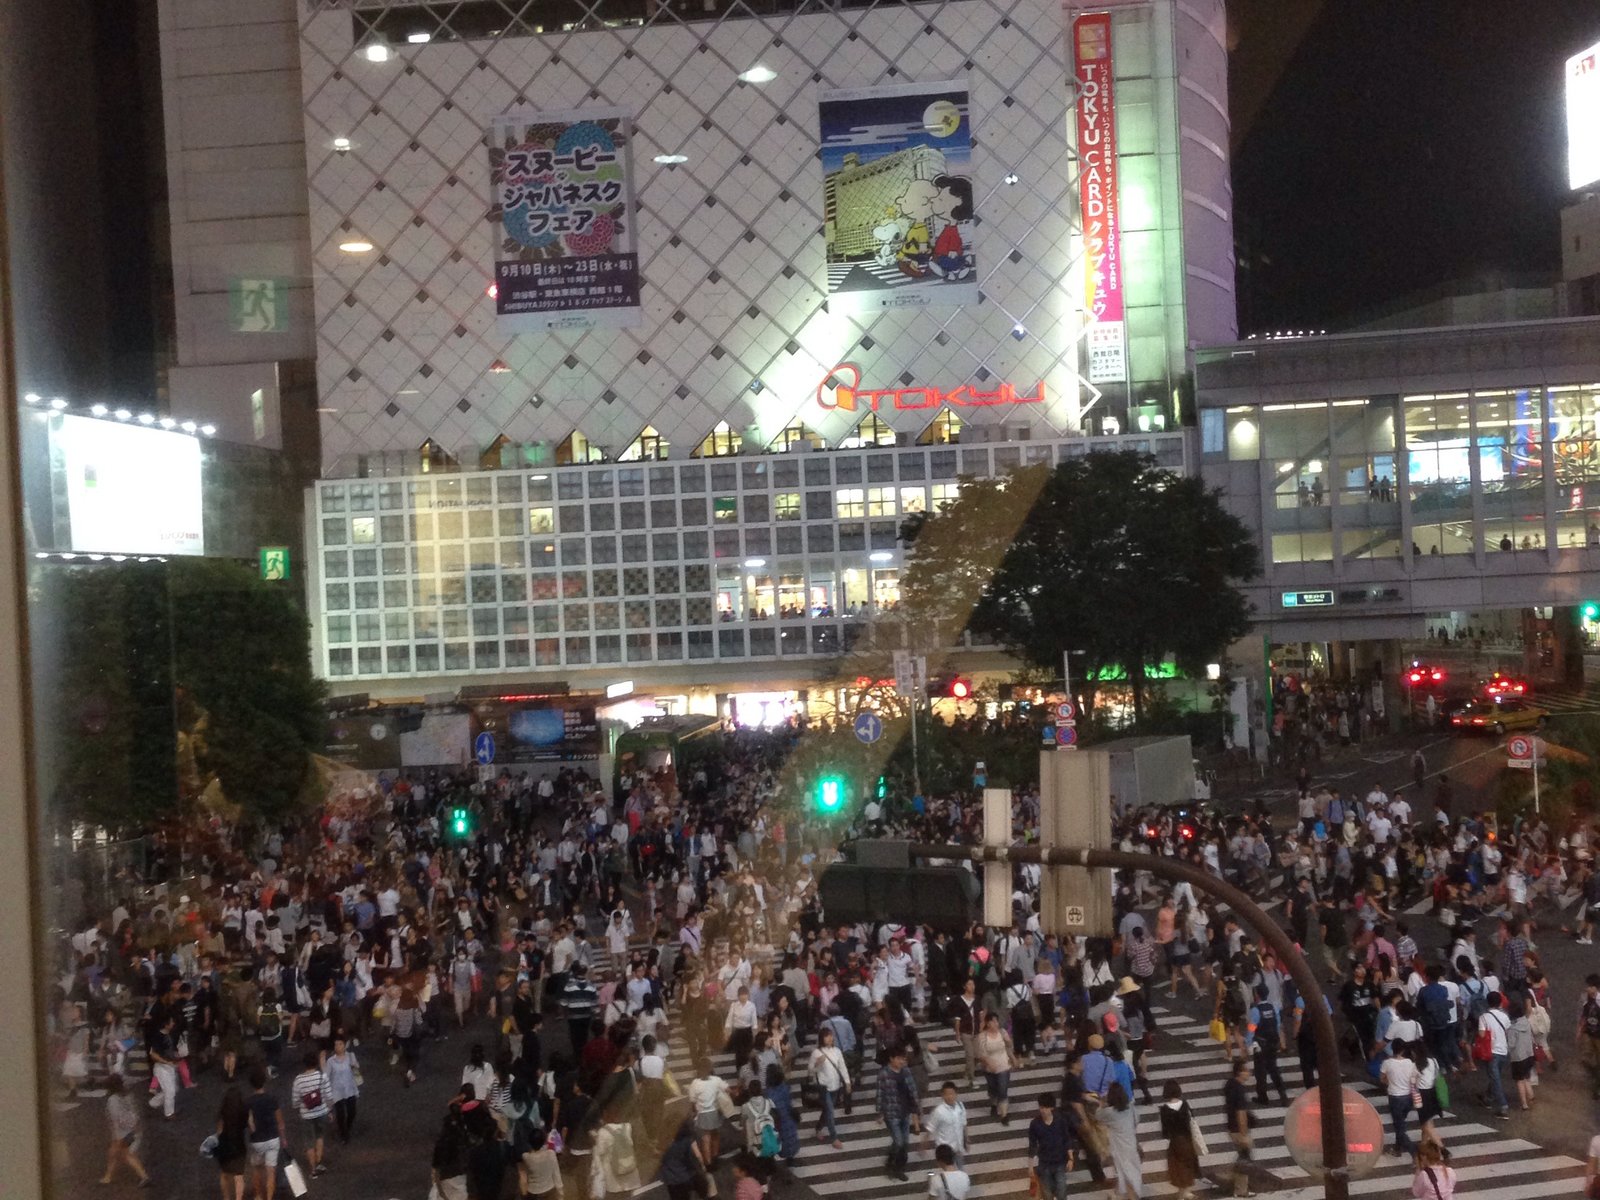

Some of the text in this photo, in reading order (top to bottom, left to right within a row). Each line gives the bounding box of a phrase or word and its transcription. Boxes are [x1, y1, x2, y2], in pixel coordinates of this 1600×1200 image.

[1082, 64, 1100, 146] TOKYU
[509, 147, 616, 176] スヌーピー
[503, 181, 622, 209] ジャパネスク
[1085, 150, 1104, 217] CARD
[529, 210, 594, 234] フェア
[857, 379, 1046, 411] TOKYU
